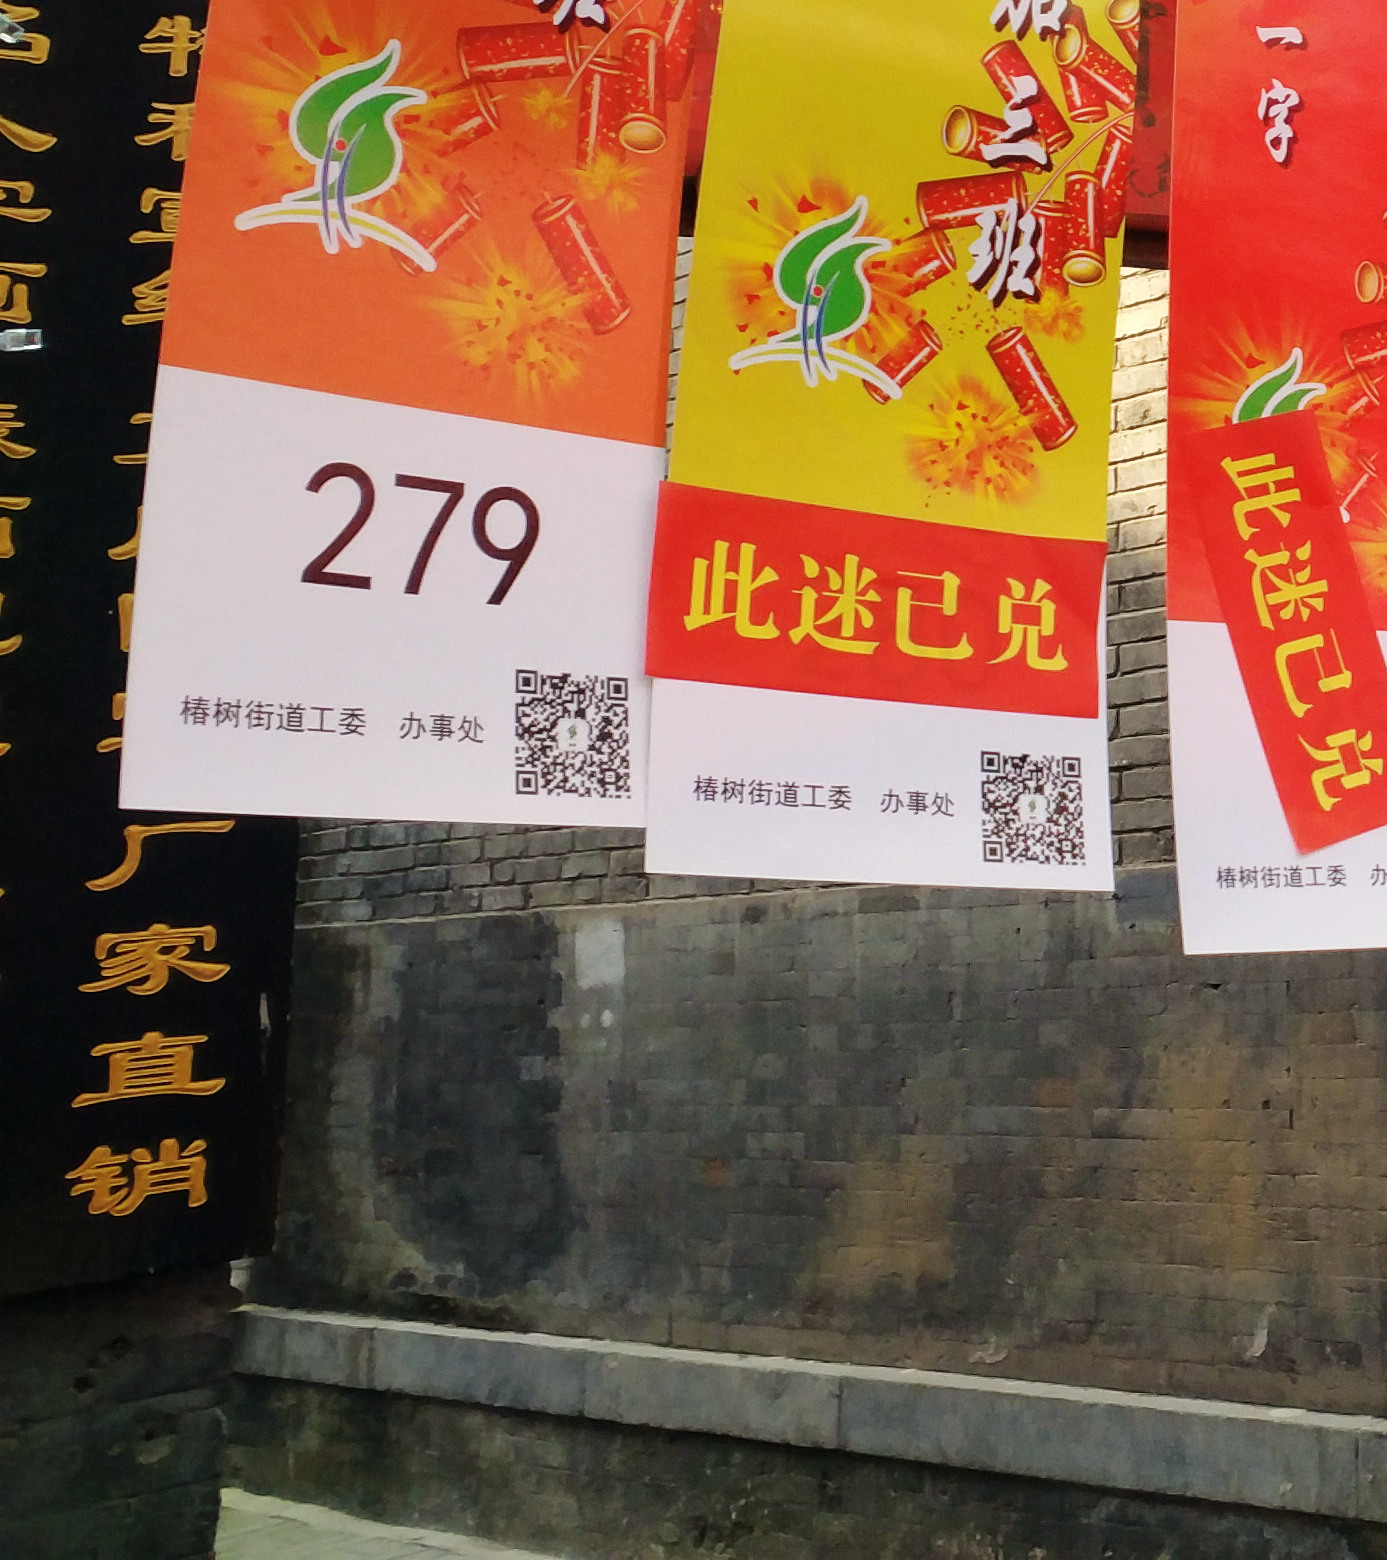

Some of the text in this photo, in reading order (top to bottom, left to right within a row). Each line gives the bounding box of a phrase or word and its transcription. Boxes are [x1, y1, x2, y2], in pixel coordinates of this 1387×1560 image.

[301, 461, 540, 606] 279
[683, 539, 1069, 672] 此迷已兑
[1220, 451, 1384, 812] 此迷已兑
[180, 695, 485, 745] 椿树街道工委 办事处
[693, 774, 956, 818] 椿树街道工委 办事处
[1216, 863, 1347, 890] 椿树街道工委
[64, 819, 236, 1218] 厂家直销
